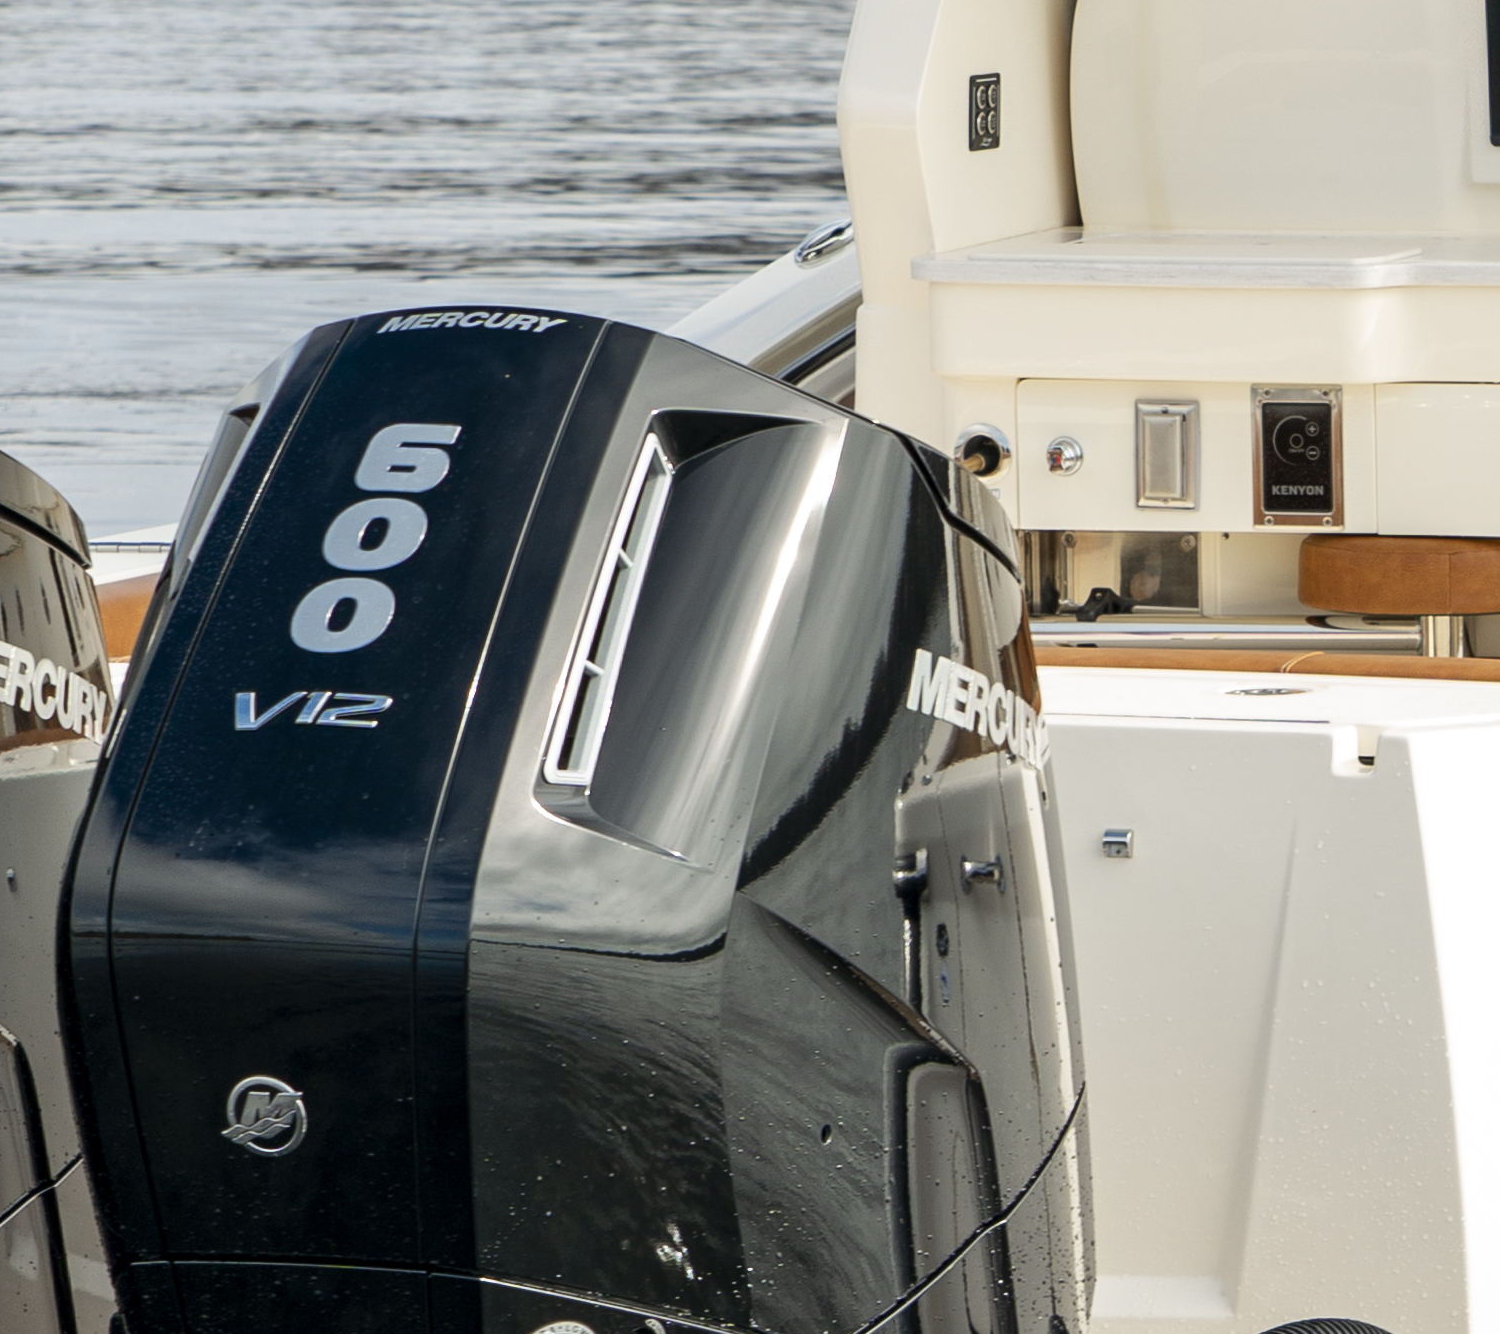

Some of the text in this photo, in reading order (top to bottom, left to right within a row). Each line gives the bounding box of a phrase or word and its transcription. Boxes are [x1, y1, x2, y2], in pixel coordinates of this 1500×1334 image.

[376, 311, 568, 334] MERCURY
[1271, 485, 1324, 496] KENYON
[290, 423, 462, 654] 600
[234, 691, 394, 731] V12
[906, 648, 1050, 772] MERCURY
